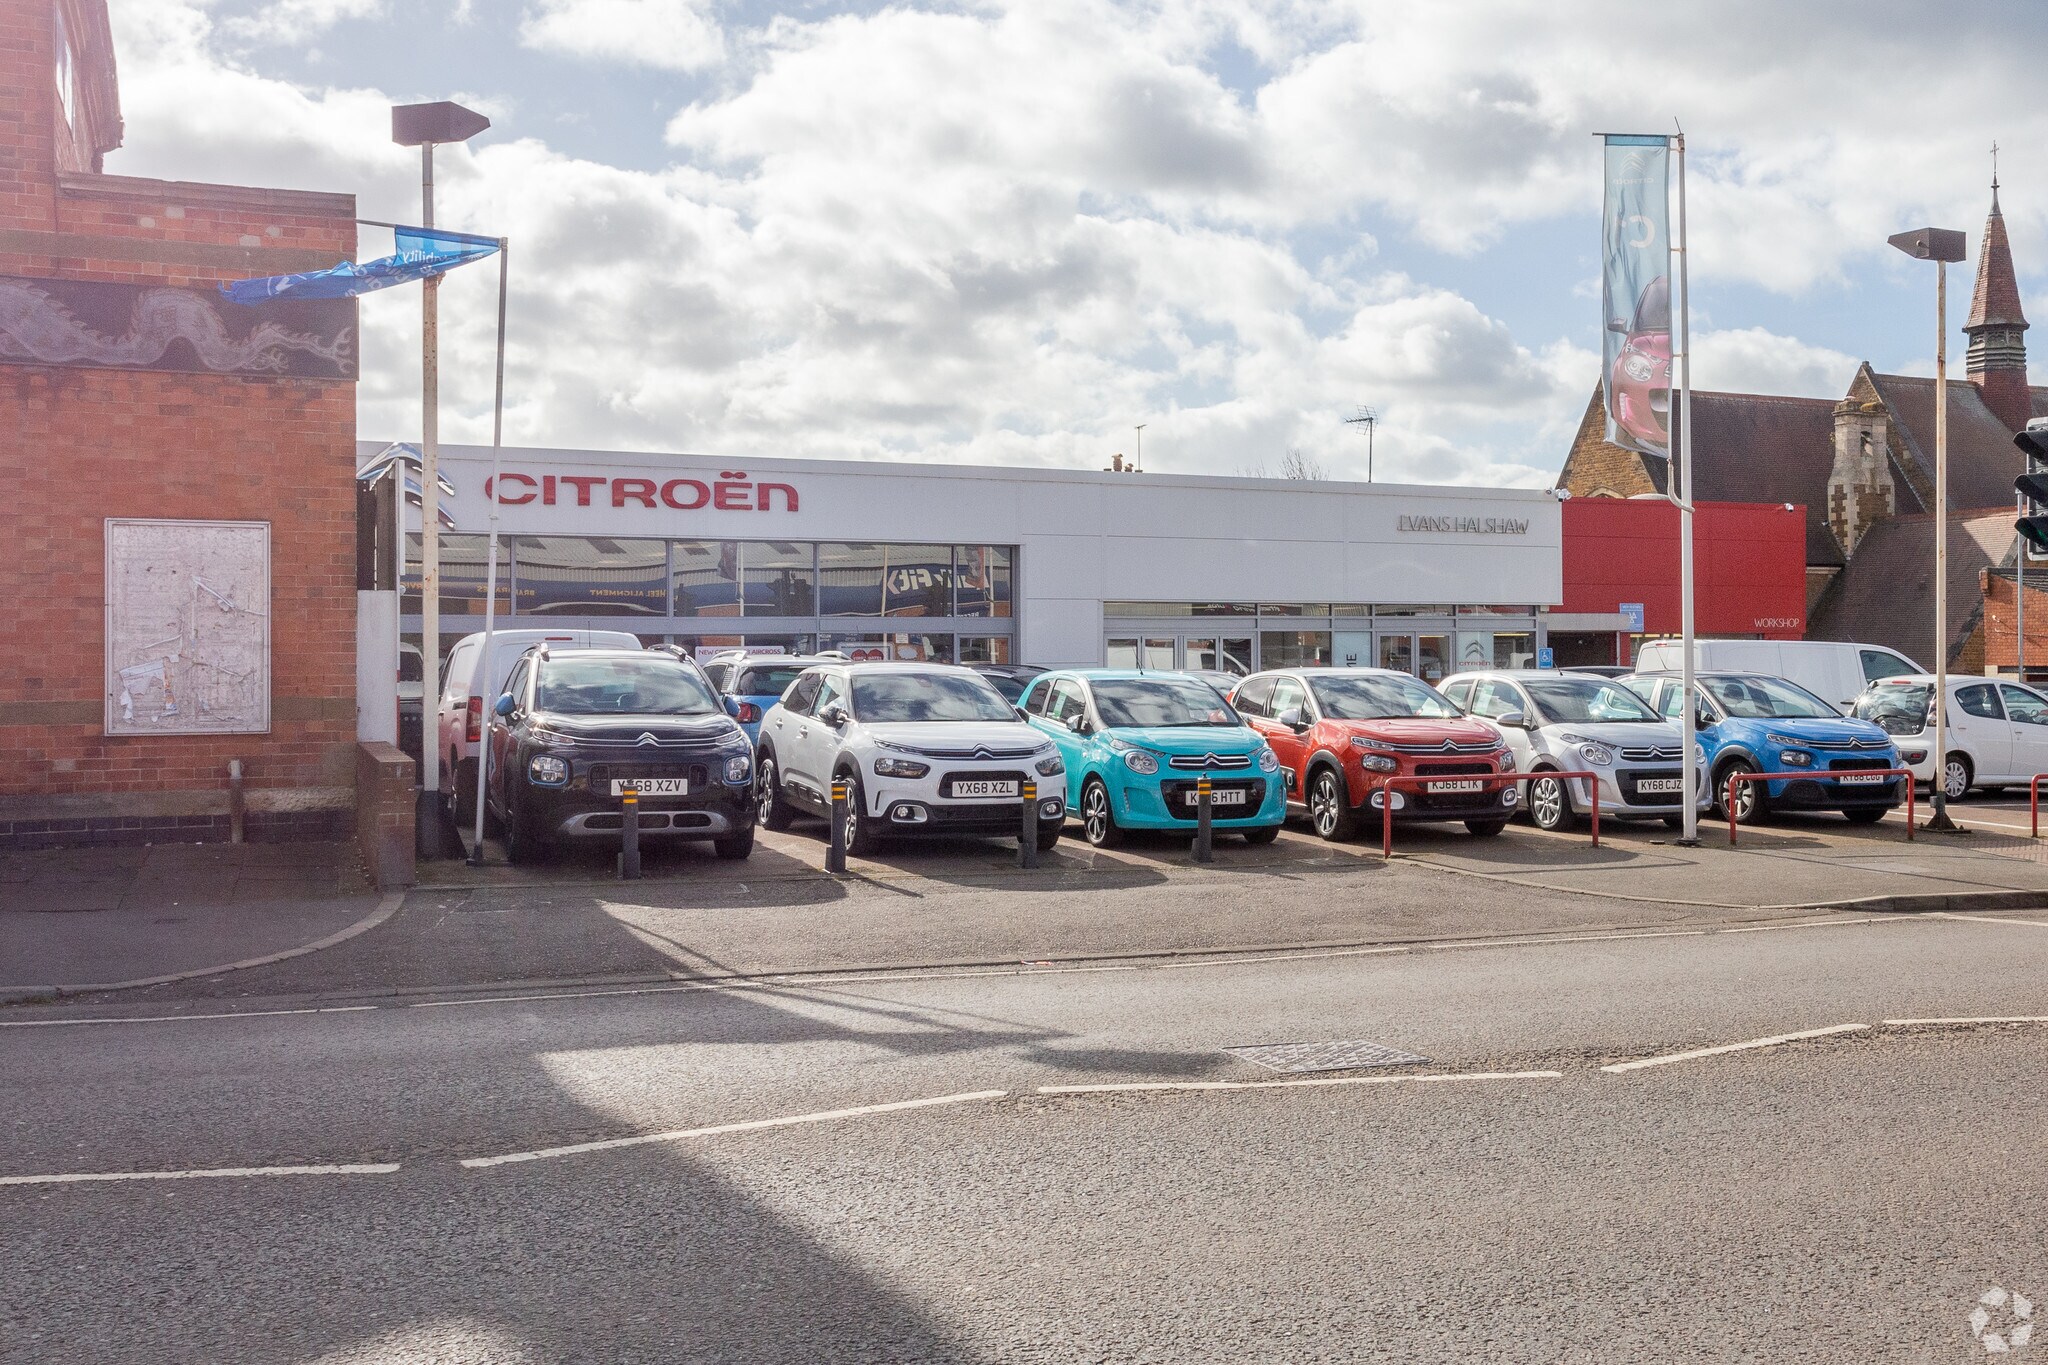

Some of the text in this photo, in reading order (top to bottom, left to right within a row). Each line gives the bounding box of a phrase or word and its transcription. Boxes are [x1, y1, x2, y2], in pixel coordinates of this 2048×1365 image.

[1397, 515, 1529, 534] EVANS HALSHAW
[1753, 617, 1800, 628] WORKSHOP
[618, 780, 681, 792] Y68 XZV
[958, 781, 1013, 794] YX68 XZL
[1641, 780, 1682, 791] KY68 CJZ
[1190, 791, 1241, 804] K6 HTT
